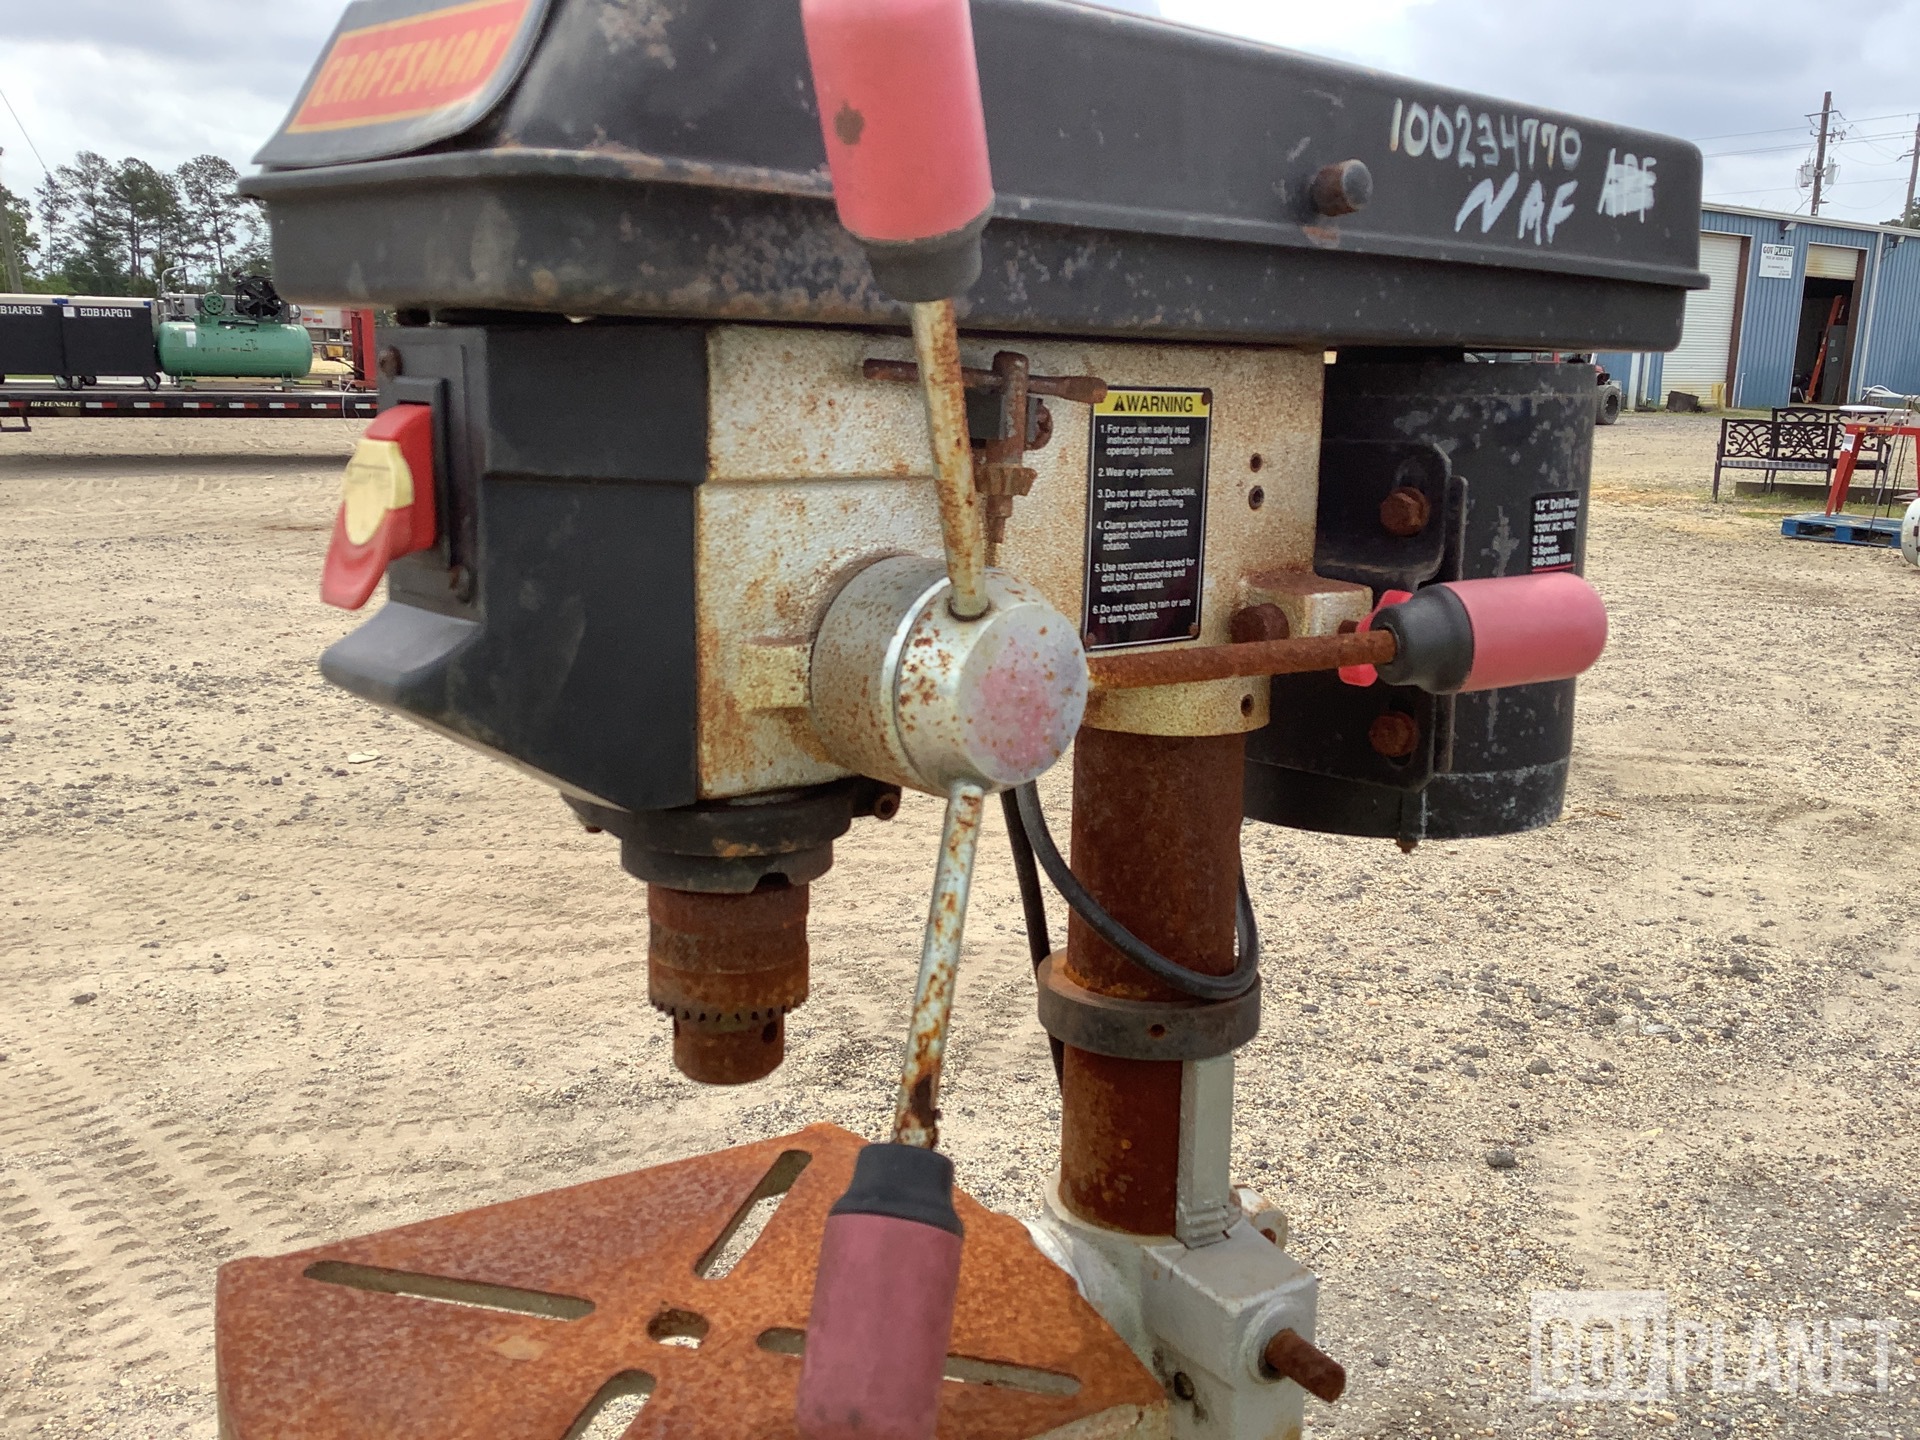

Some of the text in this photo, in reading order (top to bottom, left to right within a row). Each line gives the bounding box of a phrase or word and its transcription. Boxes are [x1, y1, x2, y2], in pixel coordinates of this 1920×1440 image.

[312, 22, 514, 107] CRAFTSMAN
[1389, 97, 1582, 171] 100234770
[1775, 247, 1793, 256] PLANET
[80, 308, 132, 317] EDB1APG11
[1126, 395, 1193, 412] WARNING
[1107, 424, 1119, 433] For
[1122, 426, 1136, 435] your
[1154, 425, 1173, 434] safety
[1175, 425, 1190, 434] read
[1107, 436, 1190, 445] instruction manual before
[1106, 446, 1174, 457] operating drill press.
[1106, 468, 1125, 476] Wear
[1126, 469, 1138, 478] eye
[1140, 467, 1174, 477] protection.
[1105, 489, 1116, 497] Do
[1117, 489, 1128, 497] not
[1104, 500, 1129, 511] jewelry
[1139, 499, 1157, 507] loose
[1550, 499, 1564, 510] Drill
[1534, 512, 1563, 521] Induction
[1104, 520, 1126, 530] Clamp
[1128, 519, 1161, 529] workpiece
[1163, 519, 1169, 527] or
[1171, 518, 1188, 527] brace
[1103, 528, 1187, 542] against column to prevent
[1533, 535, 1557, 544] 6 Amps
[1103, 542, 1131, 551] rotation.
[1102, 562, 1116, 572] Use
[1118, 560, 1164, 570] recommended
[1166, 558, 1185, 569] speed
[1186, 558, 1195, 566] for
[1101, 572, 1114, 581] drill
[1116, 572, 1128, 581] bits
[1134, 570, 1172, 580] accessories
[1174, 569, 1185, 577] and
[1101, 580, 1164, 593] workpiece material.
[1100, 604, 1110, 613] Do
[1112, 604, 1123, 612] not
[1124, 602, 1148, 613] expose
[1158, 600, 1170, 608] rain
[1172, 600, 1178, 608] or
[1180, 598, 1191, 606] use
[1099, 611, 1159, 624] in damp locations.
